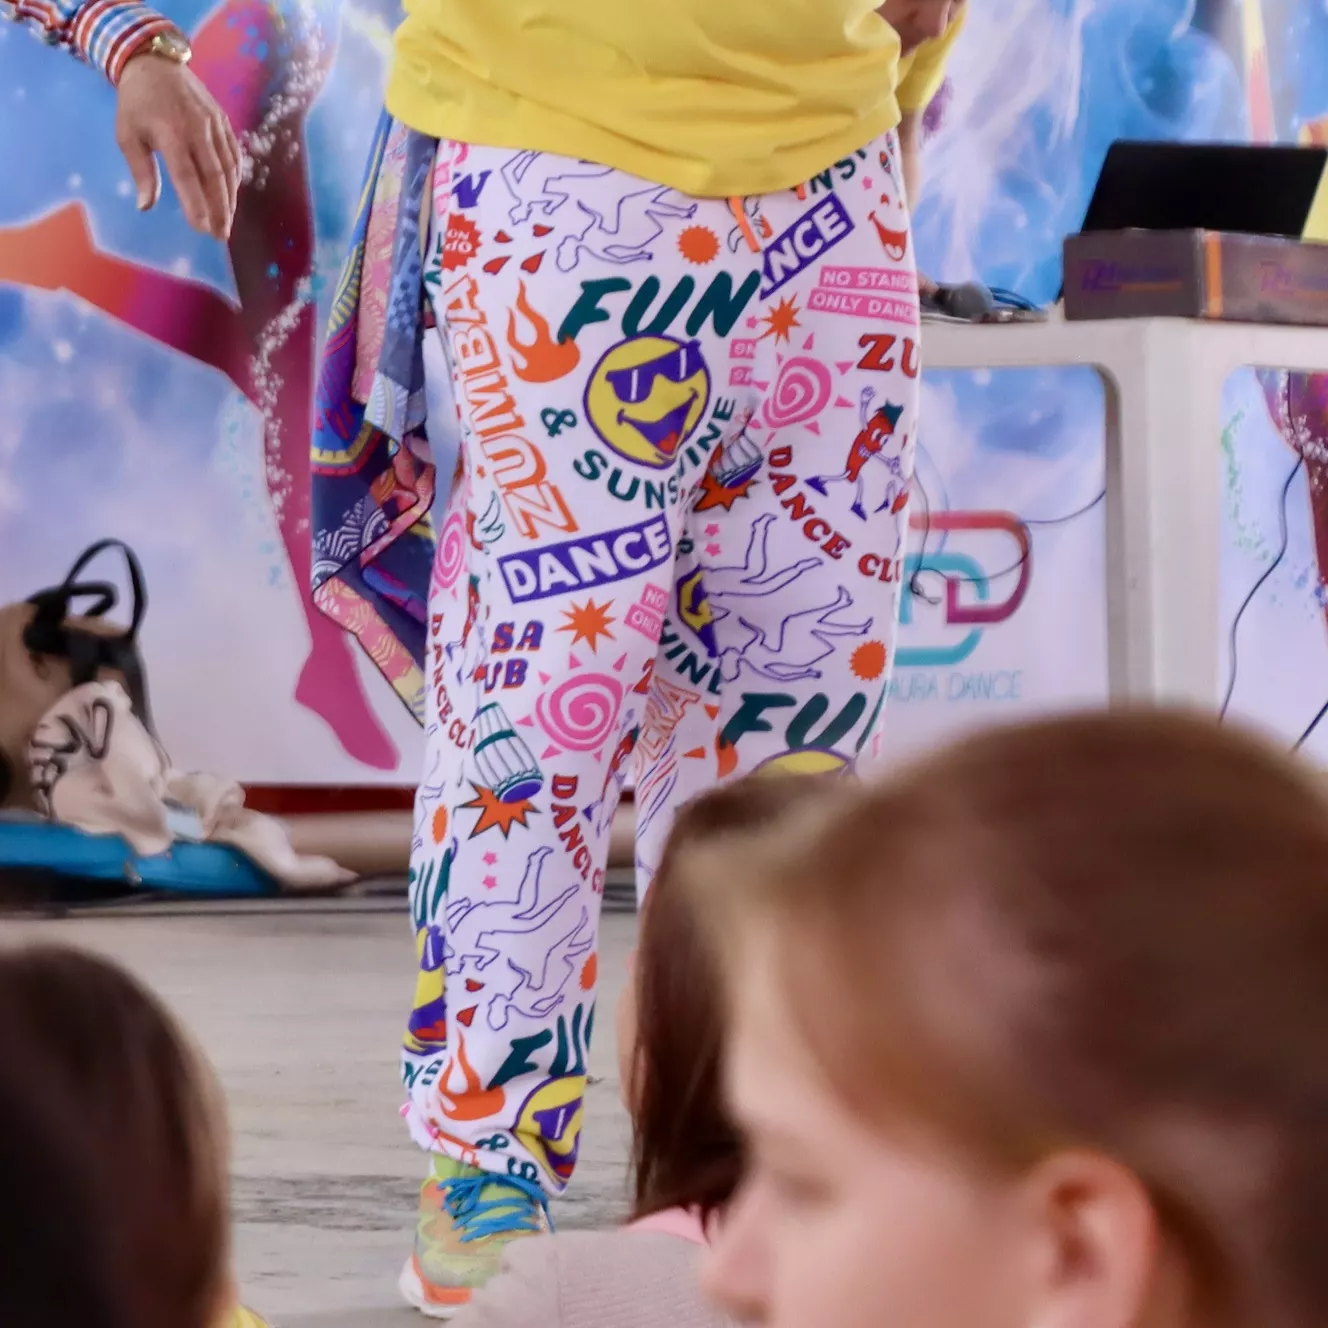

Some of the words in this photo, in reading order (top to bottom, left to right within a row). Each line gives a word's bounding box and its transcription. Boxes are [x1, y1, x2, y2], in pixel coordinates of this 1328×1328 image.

[558, 270, 762, 345] FUN
[812, 293, 862, 312] ONLY
[823, 271, 851, 286] NO
[444, 273, 580, 540] ZUMBA
[768, 445, 852, 560] DANCE
[502, 522, 671, 598] DANCE
